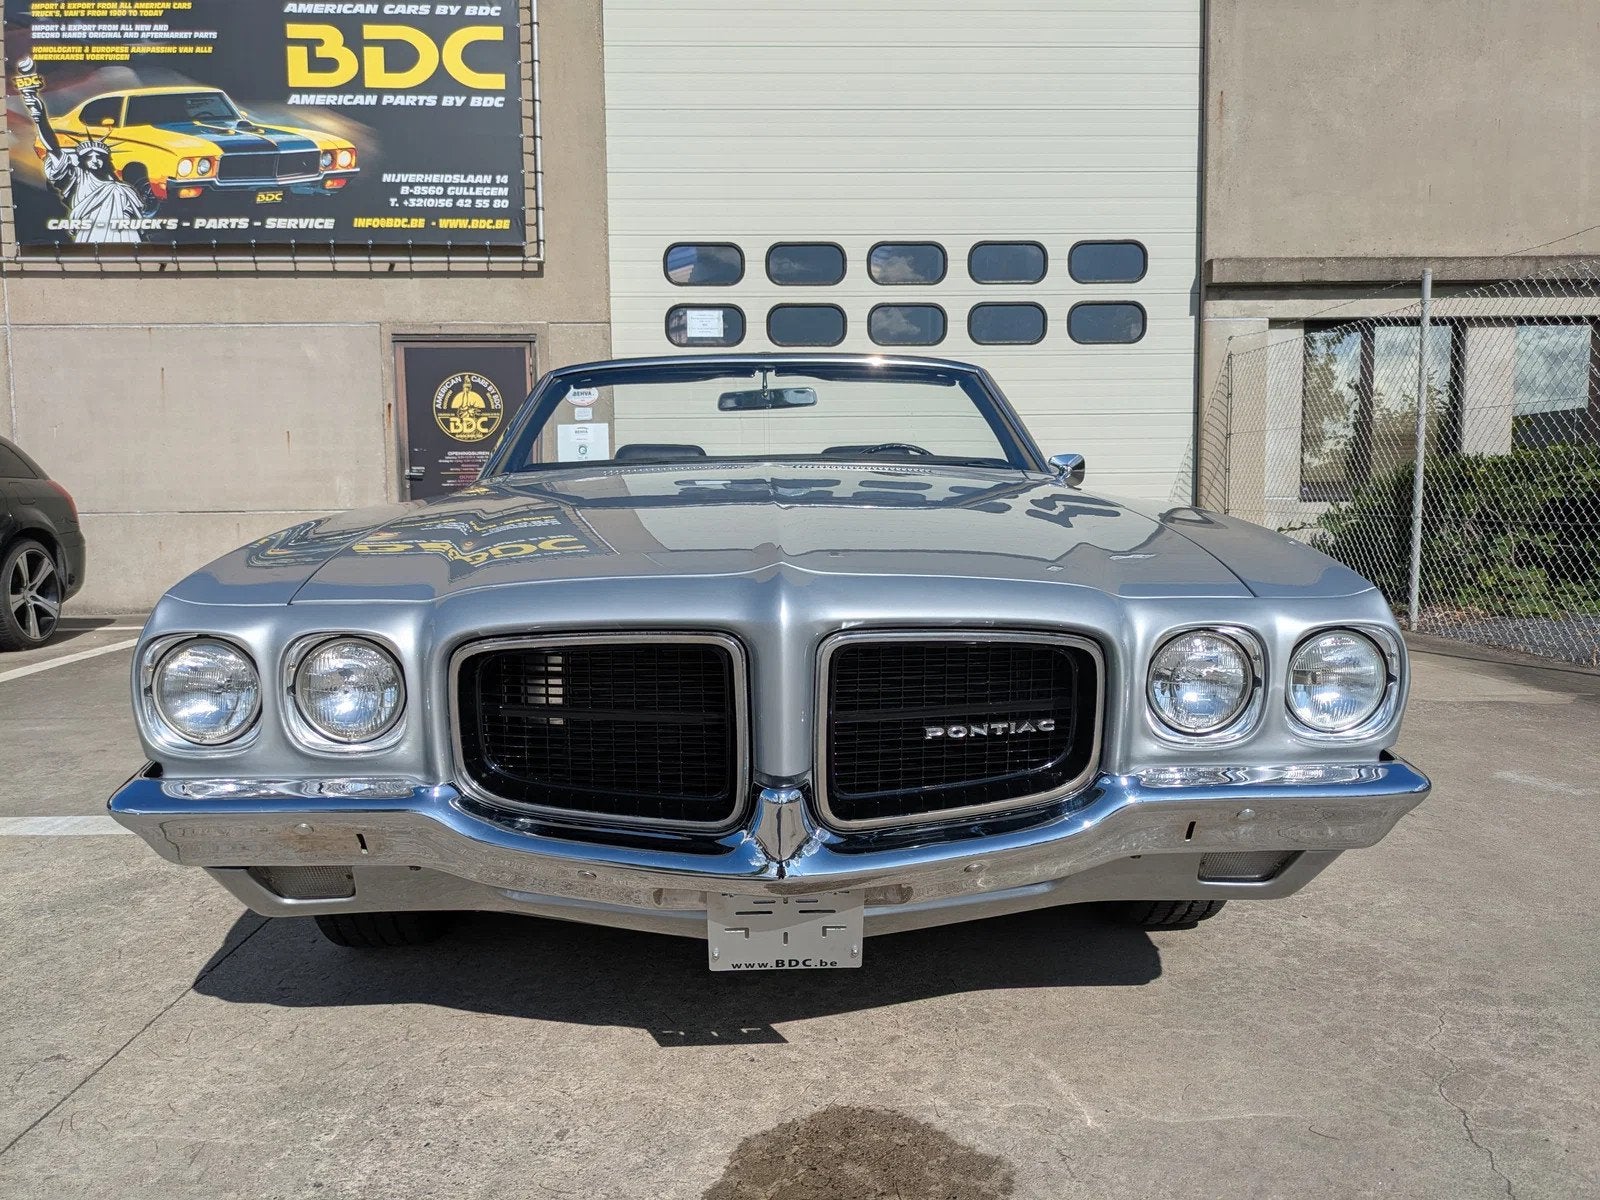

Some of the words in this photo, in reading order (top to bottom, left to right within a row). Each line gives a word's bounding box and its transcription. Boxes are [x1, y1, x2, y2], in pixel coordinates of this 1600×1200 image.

[284, 3, 378, 14] AMERICAN
[383, 4, 430, 15] CARS
[436, 5, 461, 16] BY
[465, 6, 501, 17] BDC
[286, 23, 506, 90] BDC
[288, 94, 378, 106] AMERICAN
[382, 95, 438, 106] PARTS
[442, 96, 466, 107] BY
[470, 96, 505, 107] BDC
[382, 173, 492, 184] NIJVERHEIDSLAAN
[495, 175, 509, 184] 14
[400, 186, 444, 195] B-8560
[447, 187, 509, 196] GULLEGEM
[256, 193, 283, 202] BDC
[390, 198, 399, 207] T.
[403, 198, 453, 208] +32(0)56
[456, 199, 472, 208] 42
[474, 199, 490, 208] 55
[493, 199, 509, 208] 80
[47, 219, 92, 230] CARS
[110, 219, 178, 230] TRUCK'S
[194, 218, 249, 230] PARTS
[265, 218, 335, 229] SERVICE
[353, 217, 426, 228] INFO@BDC.BE
[439, 218, 510, 229] WWW.BDC.BE
[435, 376, 462, 409] AMERICAN
[470, 376, 489, 388] CARS
[492, 393, 501, 409] BDC
[450, 417, 489, 433] BDC
[923, 718, 1055, 739] PONTIAC
[731, 958, 838, 969] www.BDC.be
